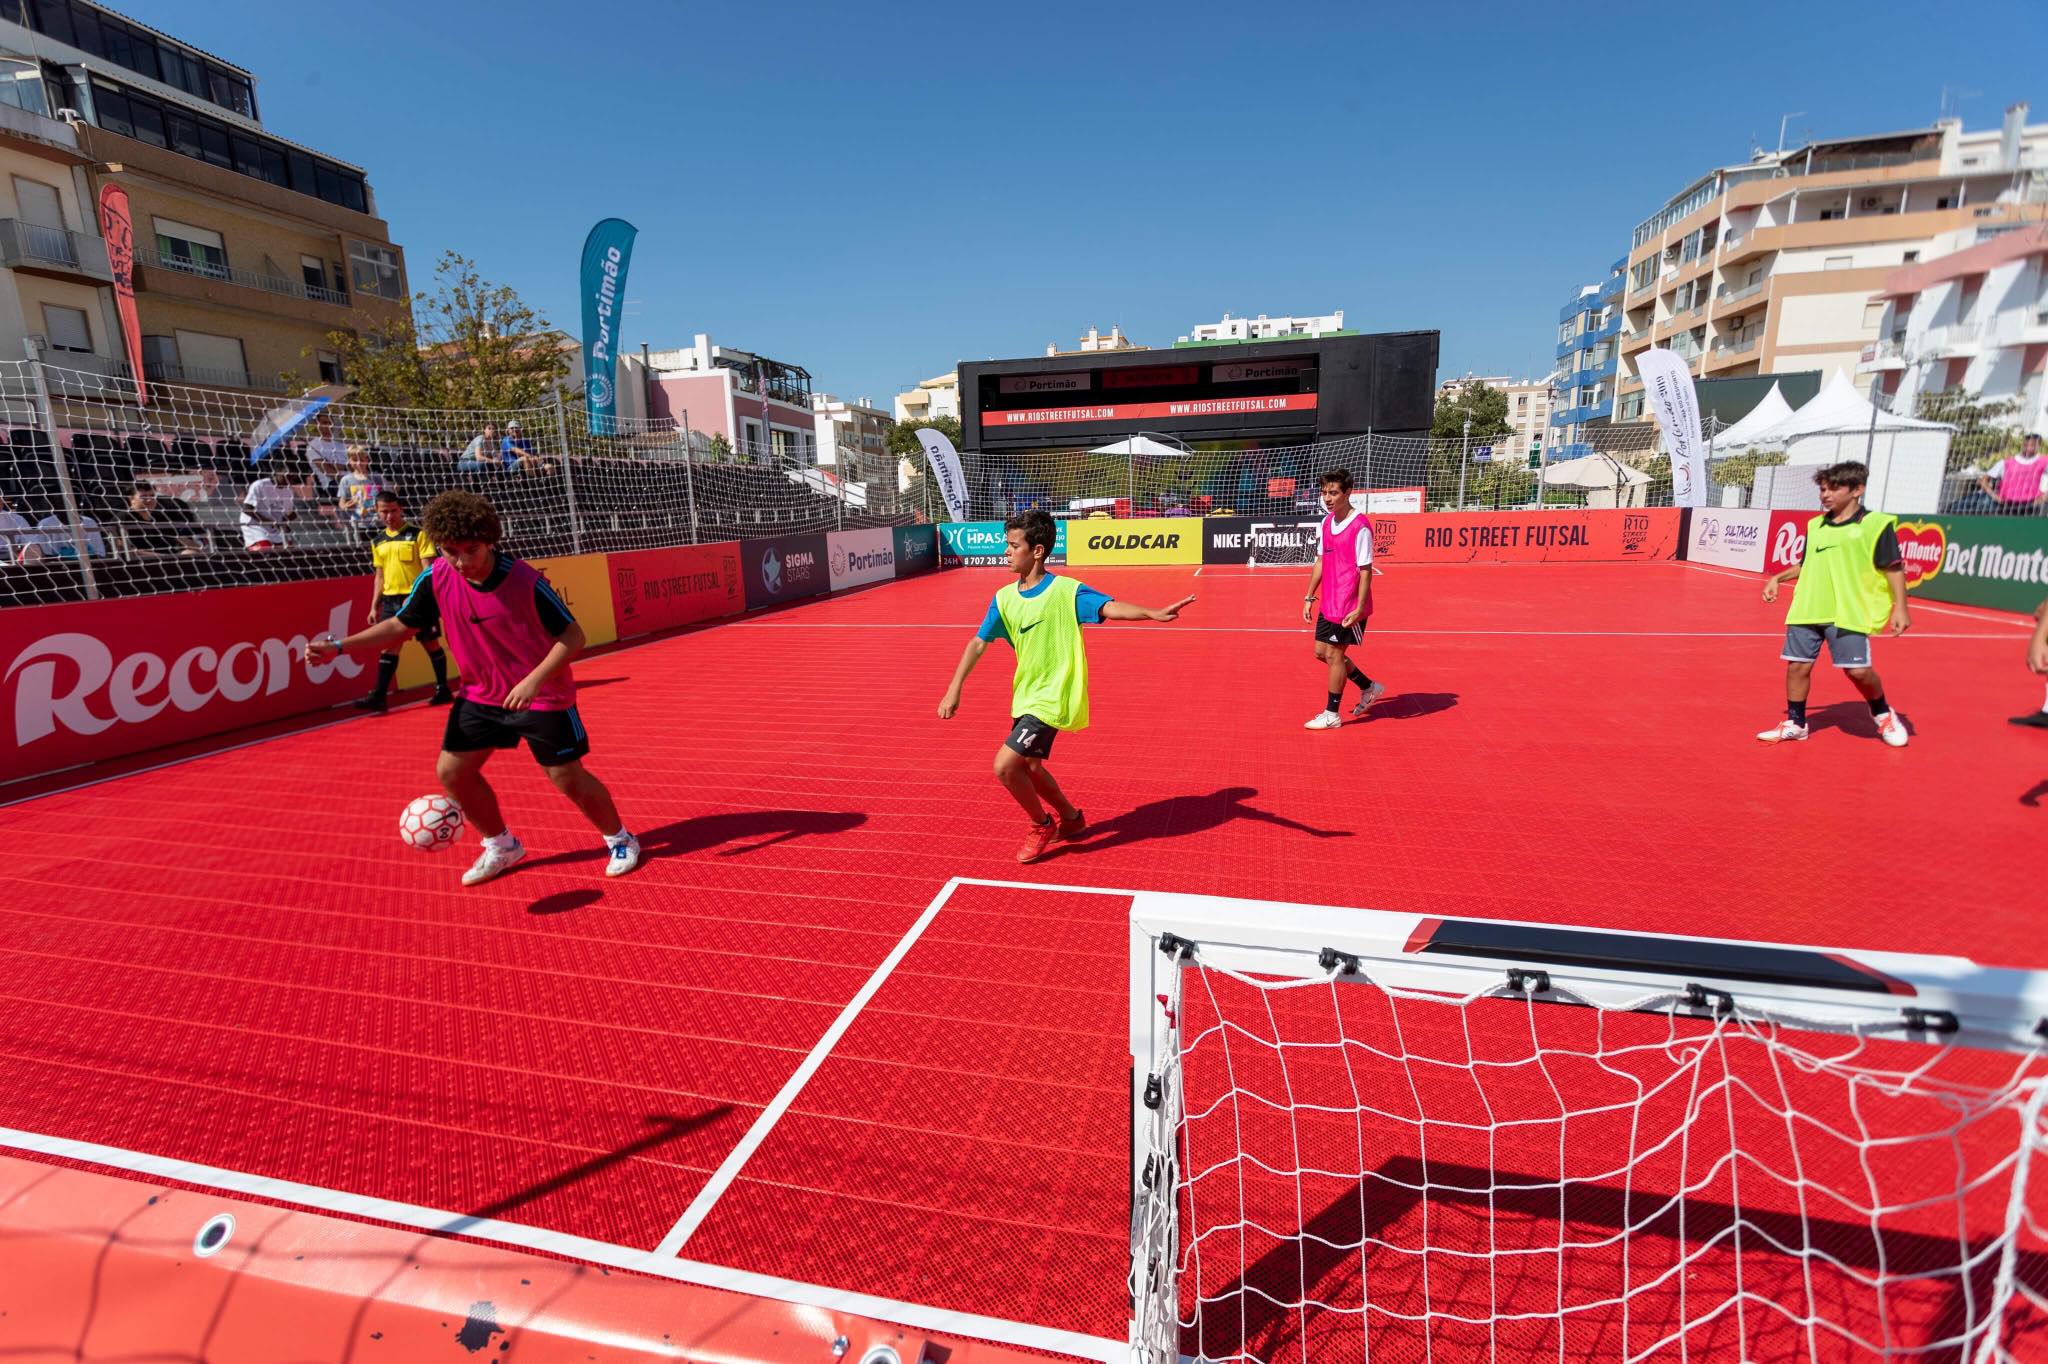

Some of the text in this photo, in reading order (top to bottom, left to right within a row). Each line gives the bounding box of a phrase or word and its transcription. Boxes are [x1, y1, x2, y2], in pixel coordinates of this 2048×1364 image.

[593, 246, 621, 362] Portimão
[1246, 366, 1298, 378] Portimão
[1030, 379, 1077, 390] Portimão
[1169, 398, 1287, 414] WWW.R10STREETFUTSAL.COM
[1006, 408, 1114, 422] WWW.R10STREETFUTSAL.COM
[1375, 523, 1397, 534] R10
[1624, 517, 1649, 530] R10
[1087, 534, 1180, 550] GOLDCAR
[1213, 533, 1241, 548] NIKE
[1425, 525, 1590, 548] R10 STREET FUTSAL
[785, 551, 815, 569] SIGMA
[848, 547, 893, 572] Portimão
[1906, 541, 1942, 562] Monte
[1942, 542, 1979, 577] Del
[943, 556, 1009, 566] 24H 707 28 28
[786, 566, 811, 583] STARS
[643, 580, 660, 601] R10
[661, 574, 691, 599] STREET
[693, 571, 721, 592] FUTSAL
[3, 600, 365, 747] Record
[1016, 728, 1037, 749] 14
